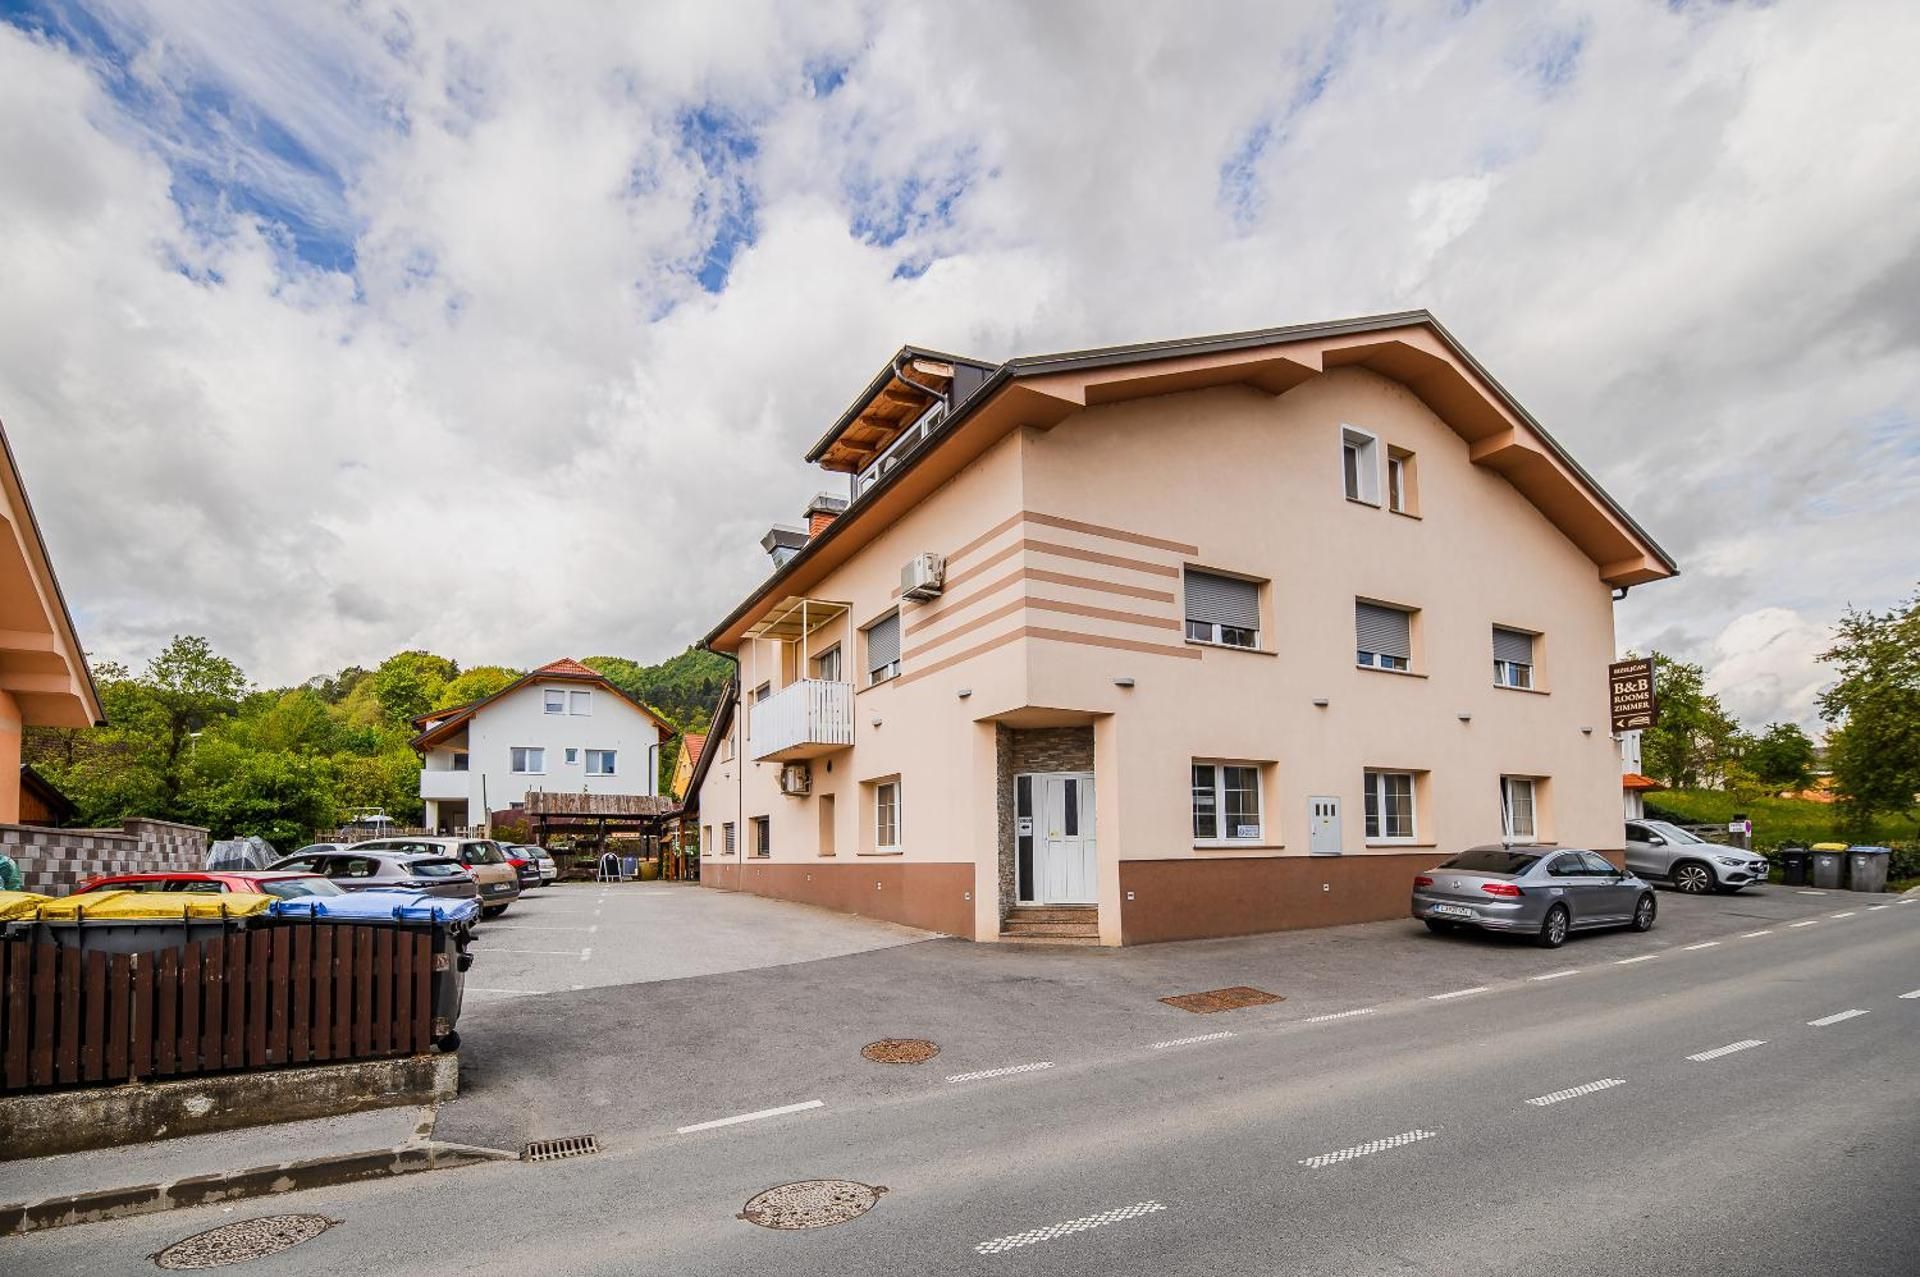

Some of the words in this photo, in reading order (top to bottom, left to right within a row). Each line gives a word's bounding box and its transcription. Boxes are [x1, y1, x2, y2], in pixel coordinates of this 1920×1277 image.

[1614, 679, 1648, 694] B&B
[1614, 692, 1649, 703] ROOMS
[1614, 701, 1650, 712] ZIMMER
